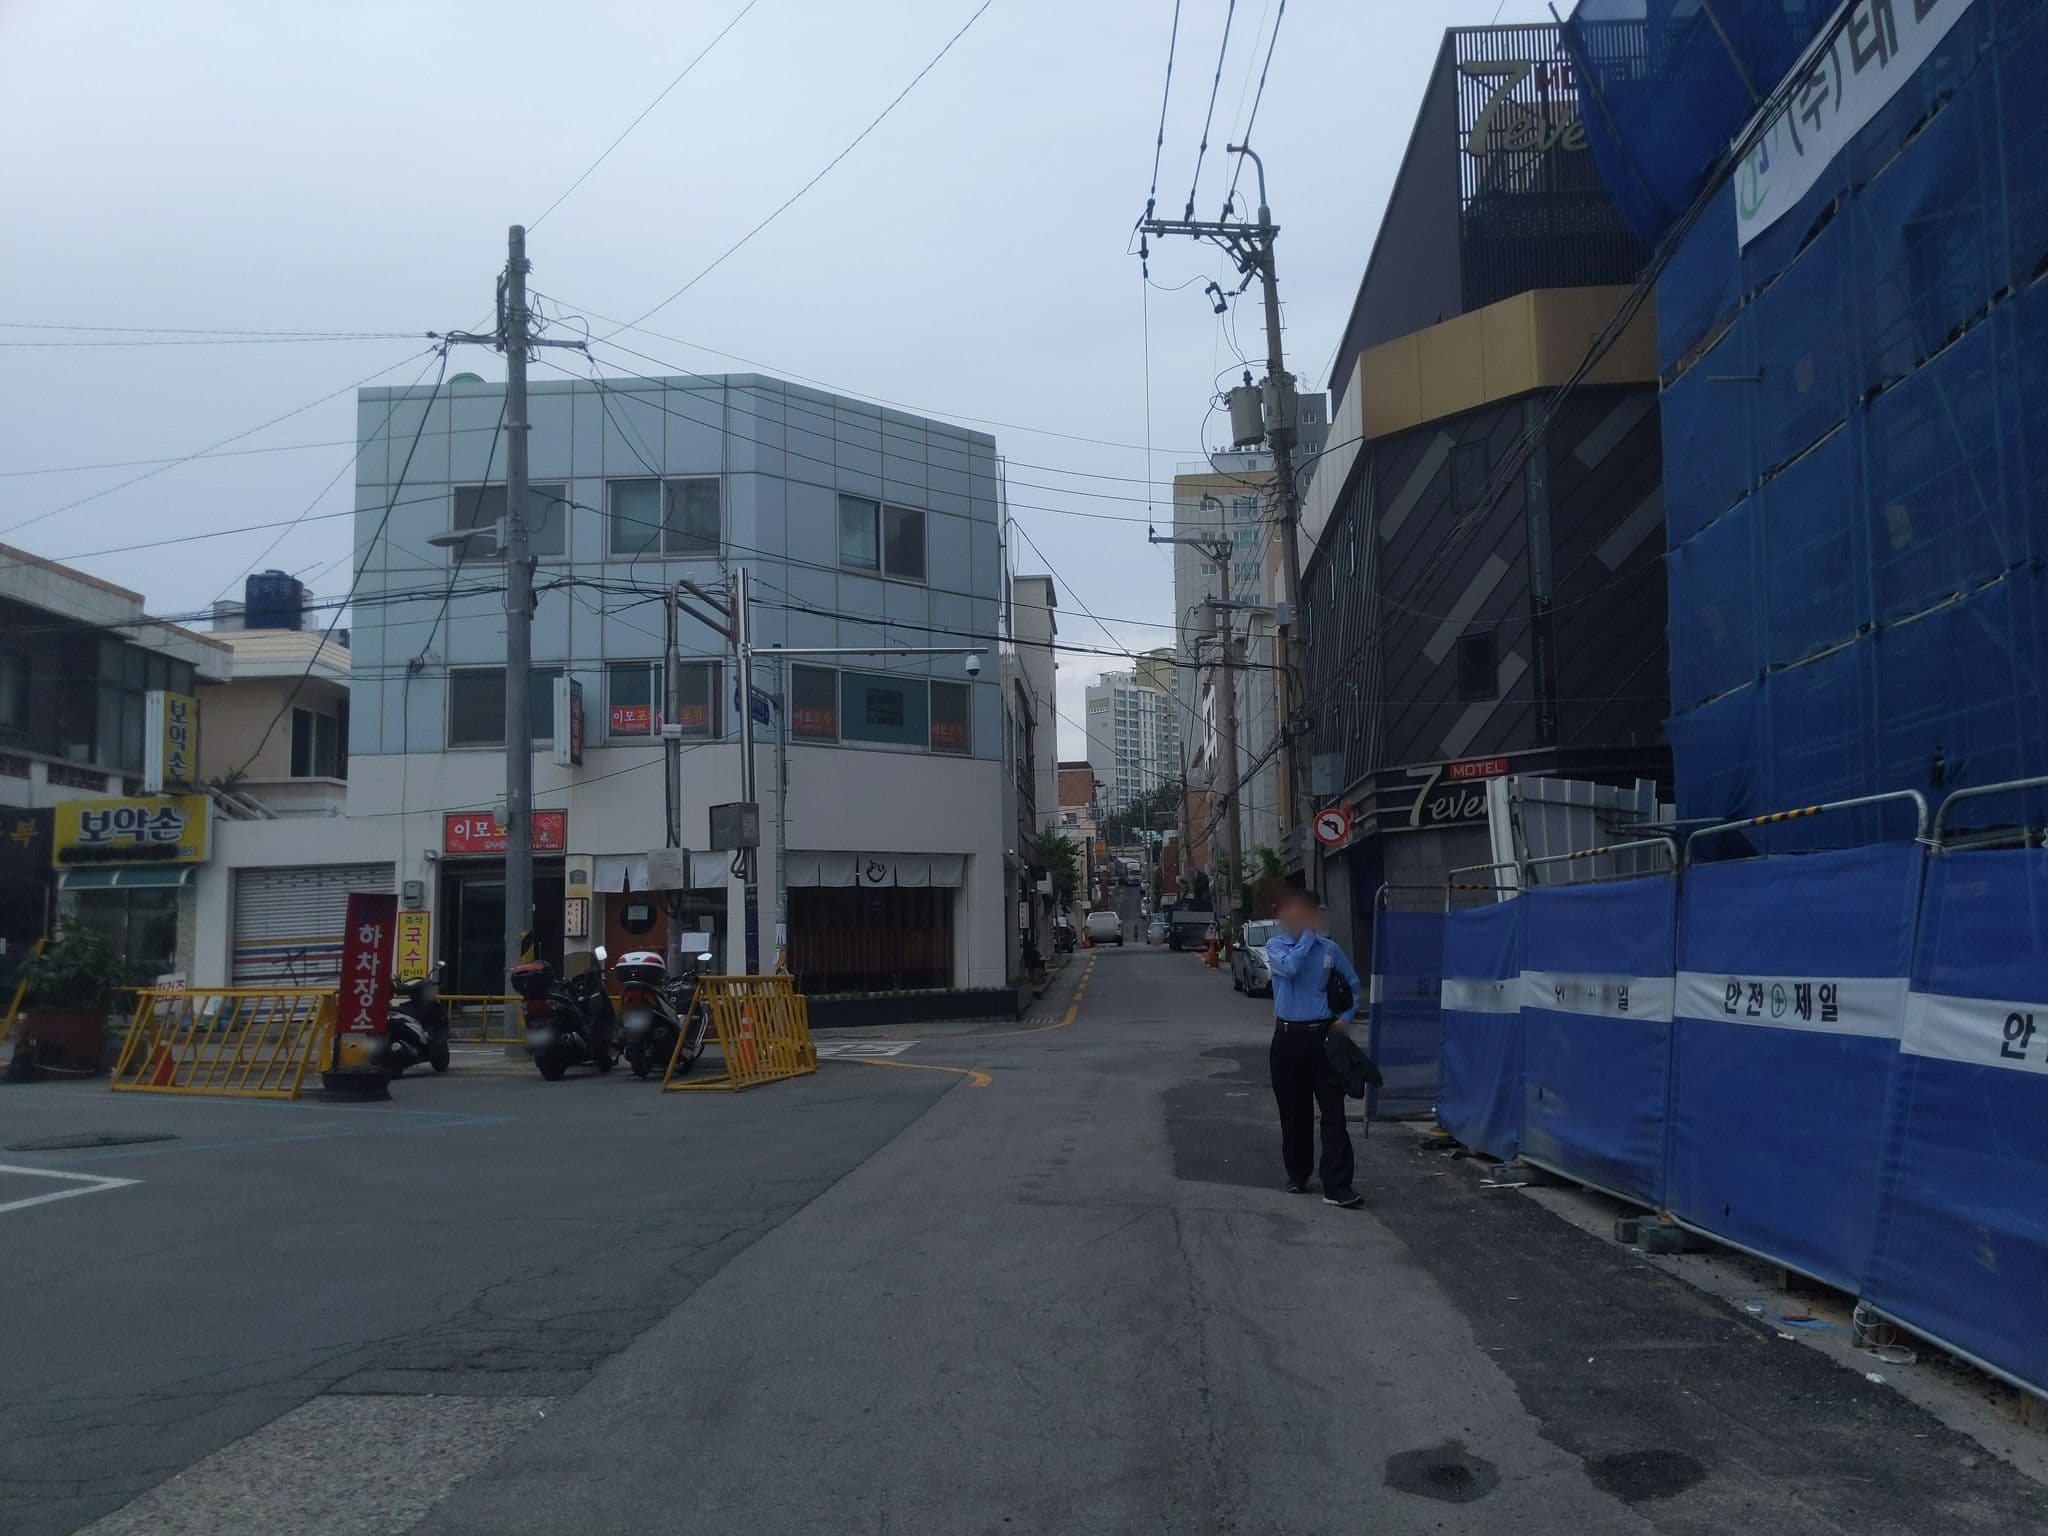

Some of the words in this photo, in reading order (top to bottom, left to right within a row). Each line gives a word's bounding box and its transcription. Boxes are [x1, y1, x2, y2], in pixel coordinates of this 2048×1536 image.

[613, 709, 650, 723] 이모포
[169, 700, 186, 776] 보약손
[1453, 761, 1503, 777] MOTEL
[79, 807, 183, 842] 보약손
[405, 927, 422, 967] 국수
[351, 923, 382, 1030] 하차장소
[1725, 982, 1764, 1016] 안전
[1793, 983, 1838, 1022] 제일
[2001, 1012, 2048, 1062] 안
